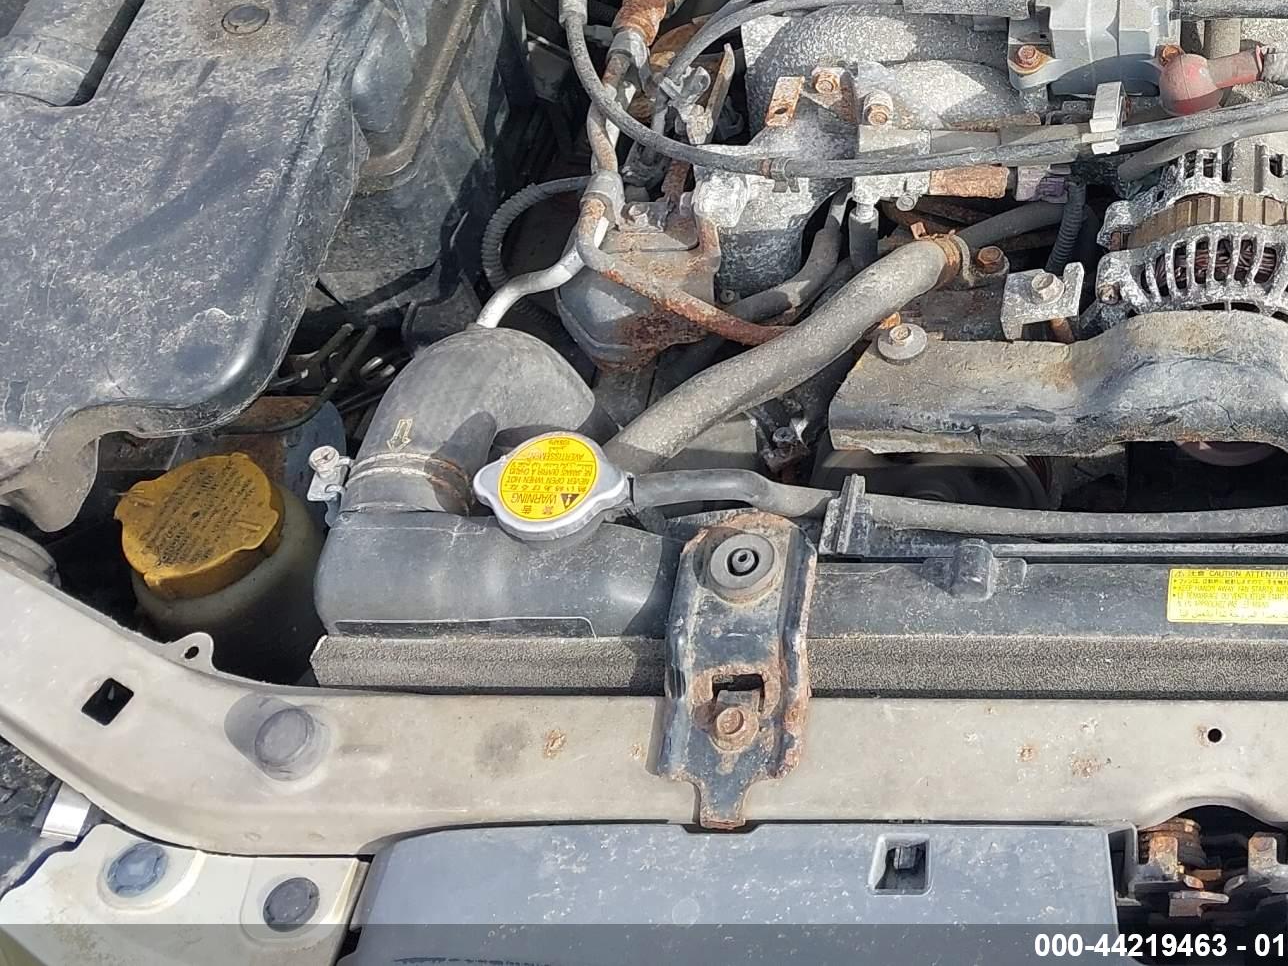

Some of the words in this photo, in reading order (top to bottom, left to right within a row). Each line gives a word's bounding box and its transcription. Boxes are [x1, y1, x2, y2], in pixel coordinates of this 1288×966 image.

[506, 475, 522, 484] HOT
[523, 475, 544, 484] WHEN
[545, 476, 565, 485] OPEN
[566, 477, 590, 485] NEVER
[511, 493, 557, 505] WARNING
